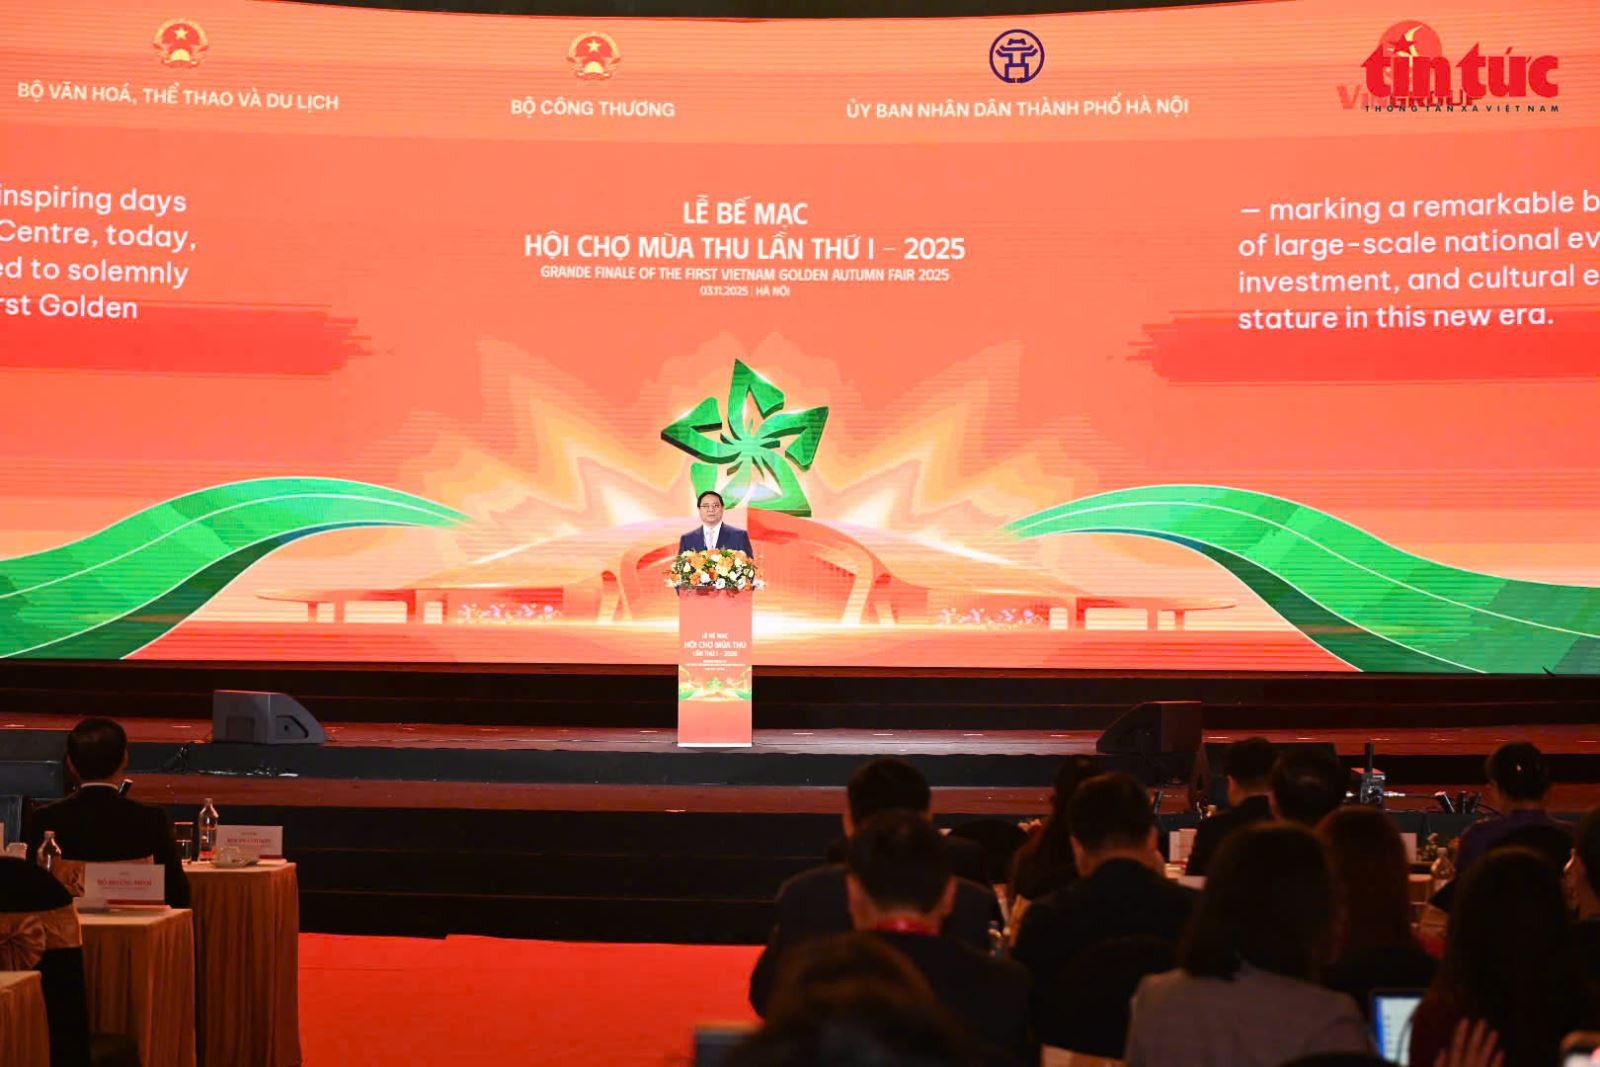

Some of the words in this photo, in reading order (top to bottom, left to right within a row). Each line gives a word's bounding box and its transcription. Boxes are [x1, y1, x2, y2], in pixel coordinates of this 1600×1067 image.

[17, 80, 44, 103] BỘ
[49, 81, 88, 101] VĂN
[92, 83, 137, 105] HOÁ,
[143, 82, 180, 104] THỂ
[183, 89, 233, 107] THAO
[238, 87, 262, 107] VÀ
[267, 92, 293, 109] DU
[297, 95, 339, 113] LỊCH
[511, 96, 536, 118] BỘ
[540, 96, 594, 115] CÔNG
[598, 100, 675, 117] THƯƠNG
[846, 98, 871, 119] ỦY
[876, 103, 913, 118] BAN
[918, 99, 969, 117] NHÂN
[974, 98, 1011, 117] DÂN
[1016, 96, 1079, 116] THÀNH
[1084, 92, 1122, 115] PHỐ
[1126, 95, 1151, 114] HÀ
[1157, 95, 1188, 117] NỘI
[0, 183, 112, 215] inspiring
[120, 187, 187, 217] days
[683, 194, 709, 224] LỄ
[717, 196, 751, 224] BẾ
[754, 202, 808, 228] MẠC
[1270, 197, 1381, 224] marking
[1388, 201, 1406, 218] a
[1413, 190, 1575, 218] remarkable
[0, 219, 98, 248] Centre,
[106, 224, 197, 253] today,
[524, 230, 569, 260] HỘI
[577, 234, 630, 261] CHỢ
[638, 232, 695, 259] MÙA
[702, 237, 749, 259] THU
[758, 231, 803, 260] LẦN
[811, 234, 861, 260] THỨ
[868, 238, 874, 260] I
[904, 237, 965, 260] 2025
[1238, 233, 1268, 257] of
[1275, 230, 1436, 261] large-scale
[1445, 227, 1559, 253] national
[0, 256, 23, 279] d
[31, 258, 60, 280] to
[68, 259, 189, 289] solemnly
[540, 265, 591, 278] GRANDE
[595, 266, 636, 279] FINALE
[639, 267, 656, 280] OF
[660, 267, 681, 280] THE
[685, 267, 717, 280] FIRST
[721, 268, 776, 281] VIETNAM
[779, 268, 828, 281] GOLDEN
[832, 268, 884, 281] AUTUMN
[888, 268, 915, 281] FAIR
[919, 268, 949, 281] 2025
[1238, 270, 1400, 294] investment,
[1408, 266, 1460, 290] and
[1468, 263, 1575, 289] cultural
[39, 293, 138, 319] Golden
[1238, 308, 1338, 330] stature
[1345, 305, 1368, 329] in
[1376, 304, 1426, 328] this
[1433, 307, 1491, 327] new
[1499, 307, 1554, 326] era.
